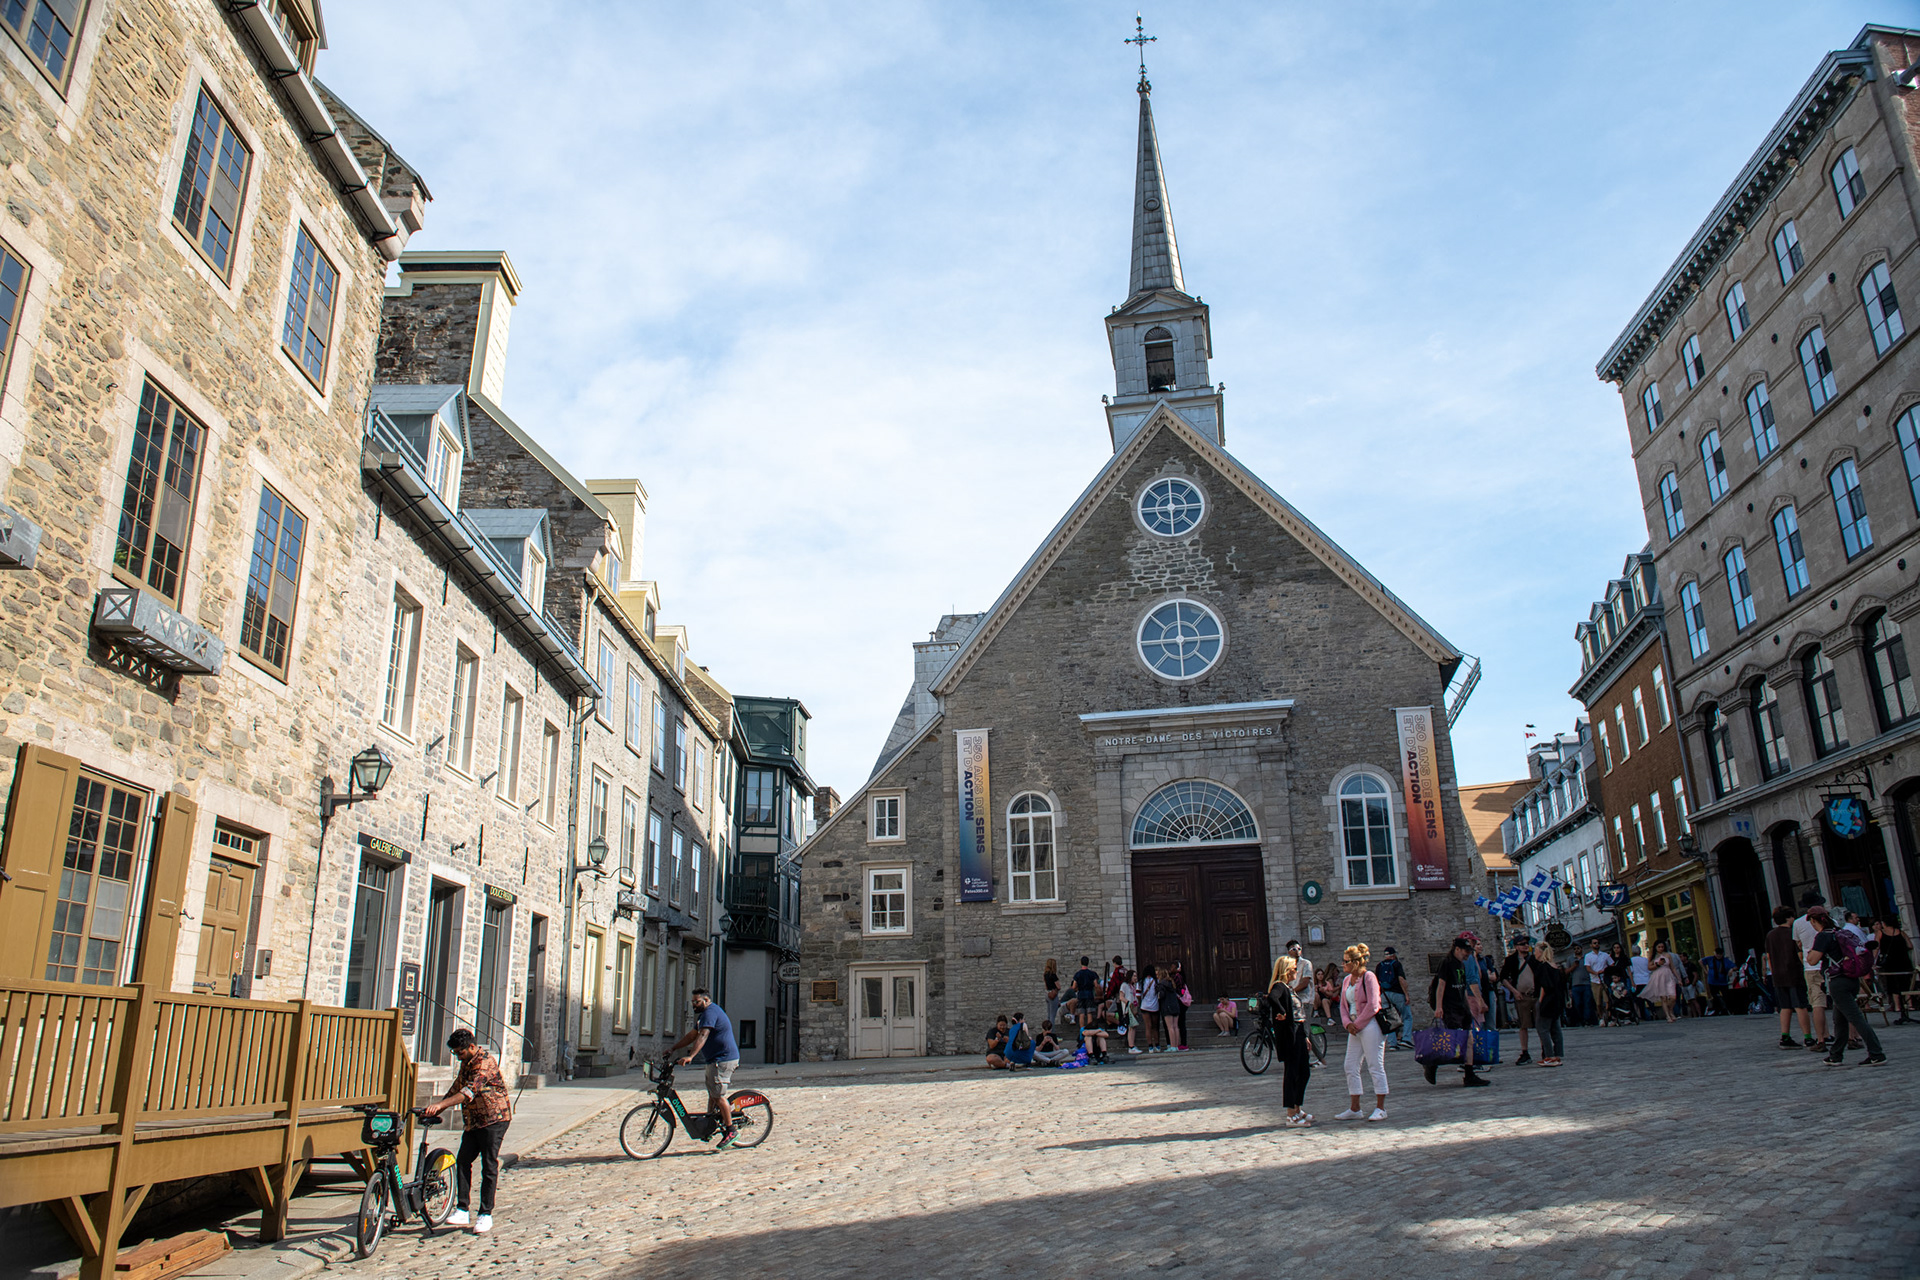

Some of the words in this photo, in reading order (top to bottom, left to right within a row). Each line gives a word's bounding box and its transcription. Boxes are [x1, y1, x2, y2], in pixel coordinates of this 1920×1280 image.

[1105, 734, 1172, 746] NOTRE-DAME
[1182, 732, 1202, 742] DES
[1212, 727, 1273, 739] VICTOIRES
[1403, 714, 1414, 733] ET
[1414, 714, 1426, 742] 350
[963, 736, 972, 754] ET
[973, 736, 982, 762] 350
[1405, 737, 1422, 804] D'ACTION
[1418, 745, 1430, 776] ANS
[964, 758, 974, 821] D'ACTION
[974, 765, 983, 794] ANS
[1421, 779, 1432, 798] DE
[975, 797, 984, 816] DE
[1424, 800, 1437, 839] SENS
[370, 837, 393, 855] GALERIE
[391, 846, 404, 860] D'ART
[976, 817, 985, 854] SENS
